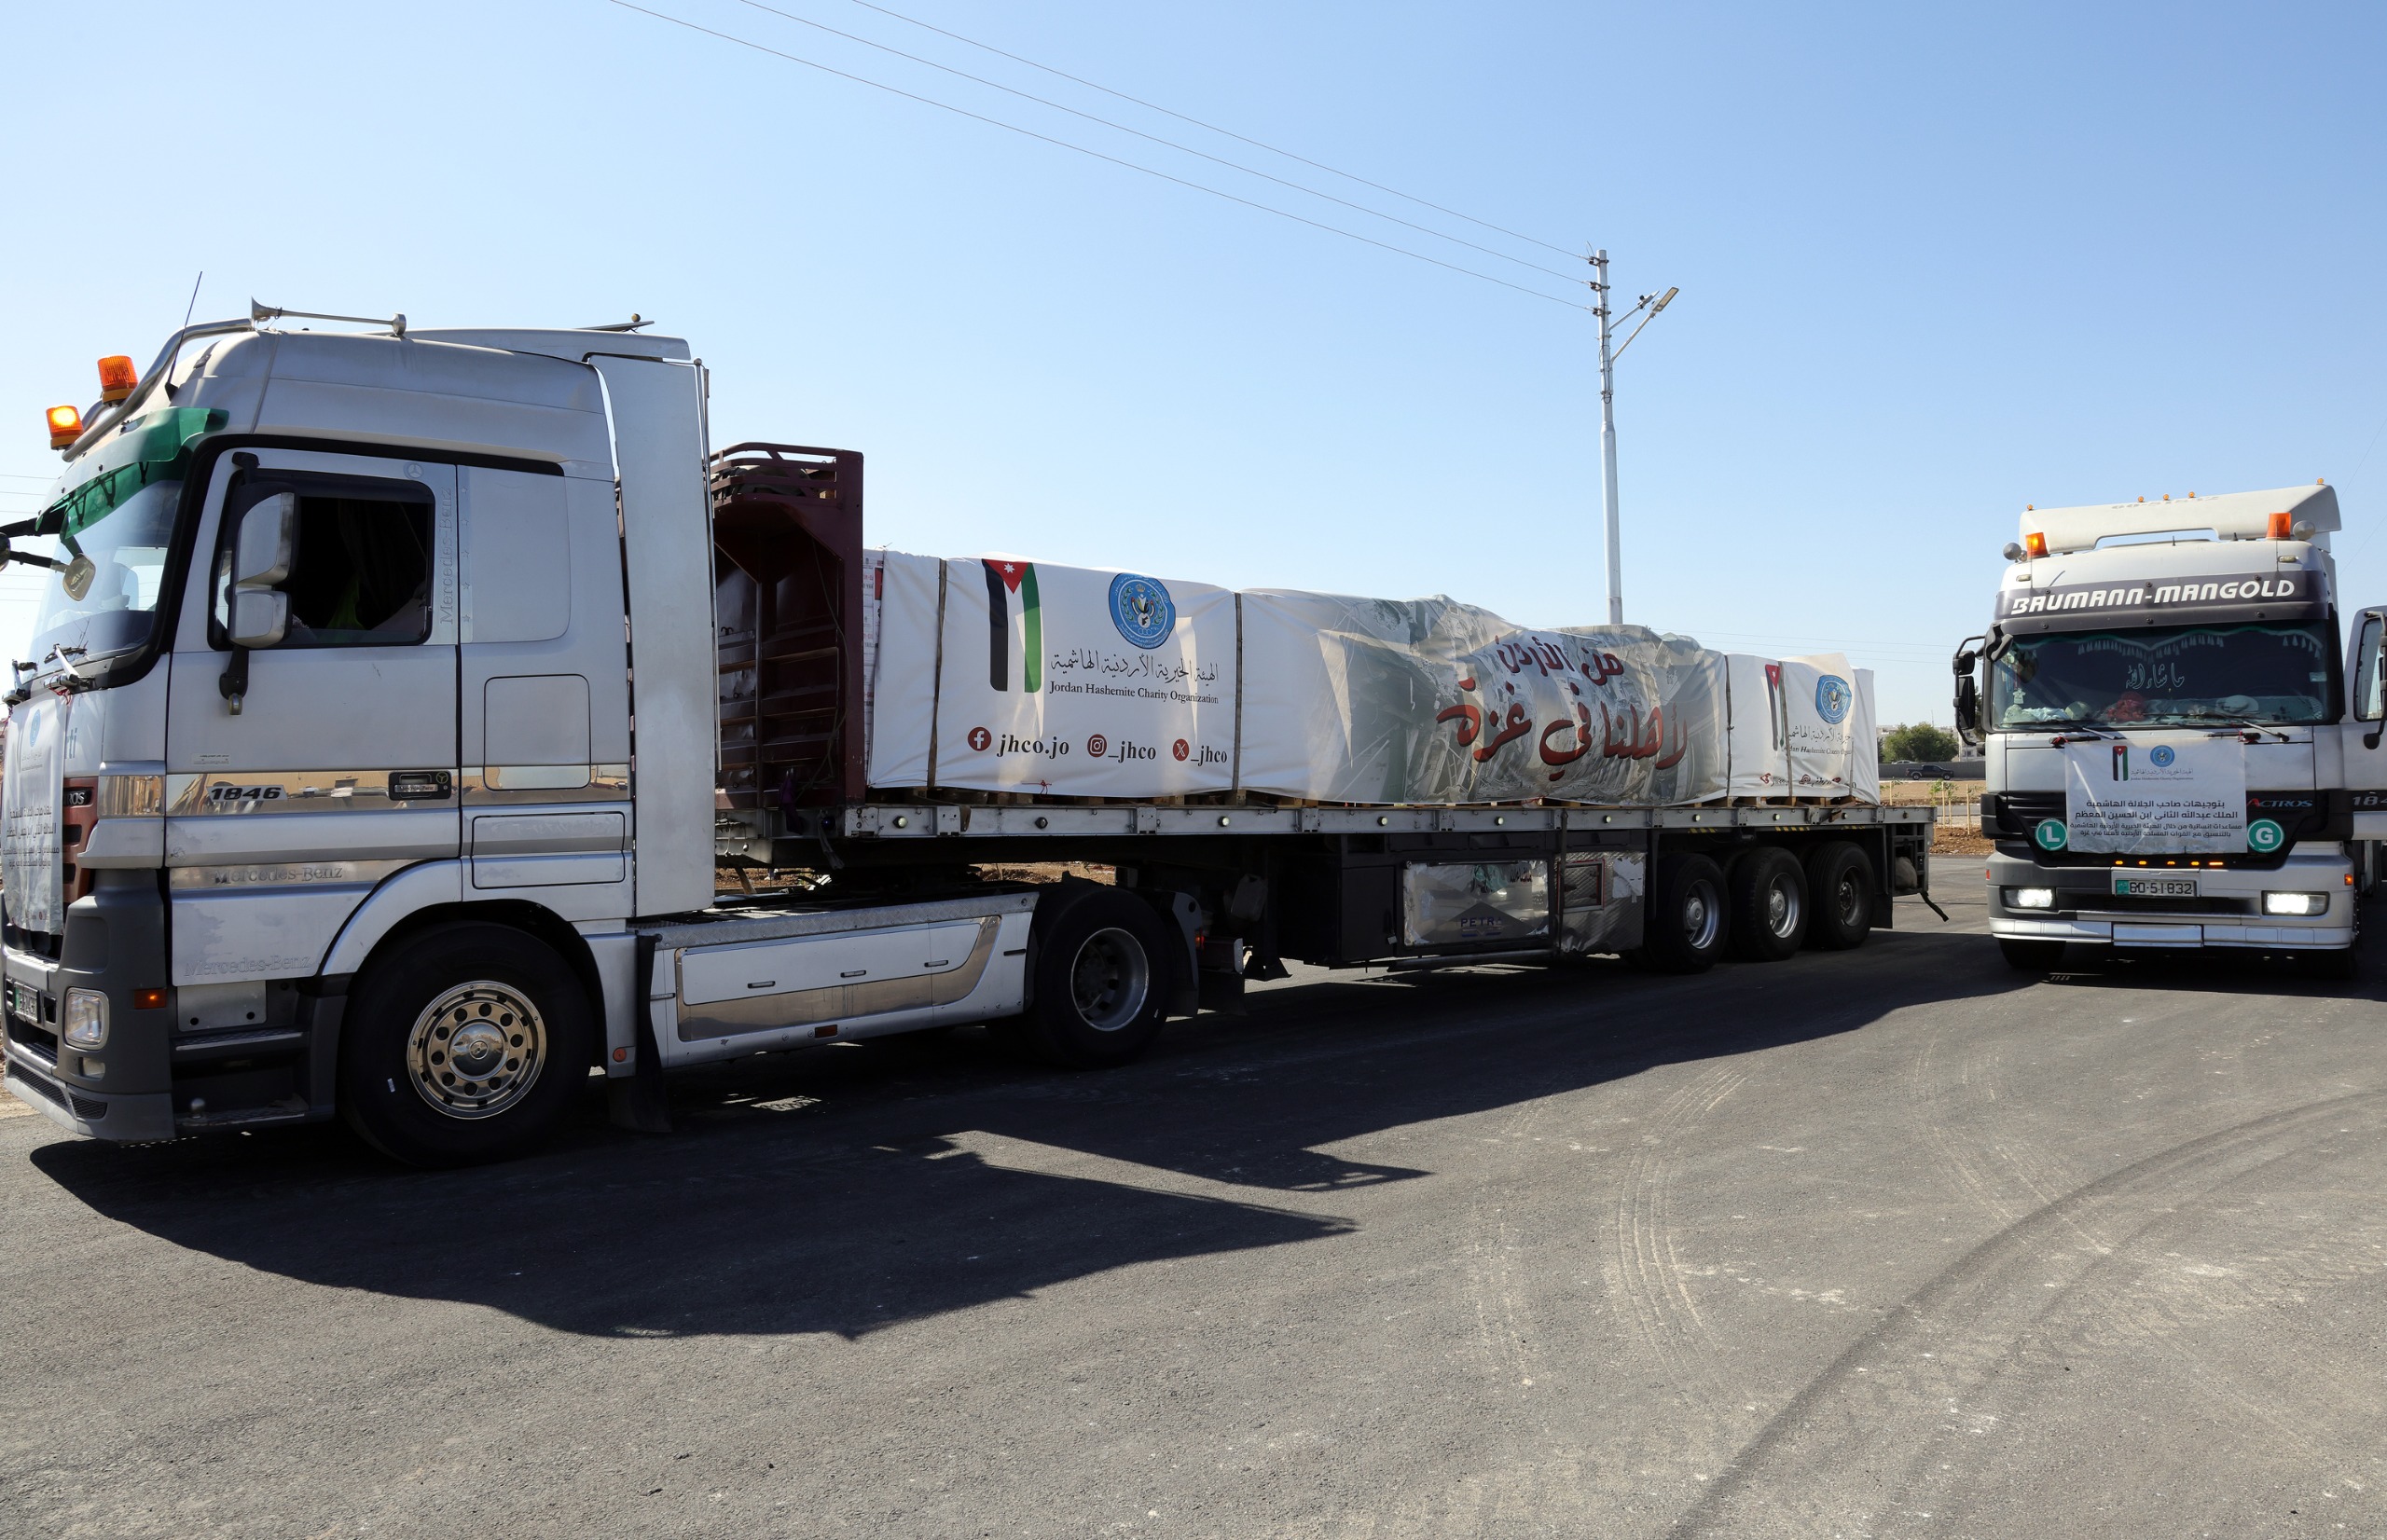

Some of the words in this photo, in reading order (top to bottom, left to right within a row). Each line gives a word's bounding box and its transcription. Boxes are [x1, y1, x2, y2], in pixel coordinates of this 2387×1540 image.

[439, 488, 455, 626] Mercedes-Benz
[2010, 579, 2296, 615] BAUMANN-MANGOLD
[1050, 648, 1100, 675] الهاشمية
[1101, 653, 1154, 678] الأردنية
[1495, 635, 1576, 678] الأردن
[1580, 646, 1624, 687] من
[1155, 656, 1193, 683] الخيرية
[1194, 661, 1220, 686] الهيئة
[1049, 681, 1083, 694] Jordan
[1085, 682, 1136, 697] Hashemite
[1138, 687, 1169, 701] Charity
[1170, 690, 1220, 705] Organization
[1435, 676, 1533, 763] غزة
[1538, 681, 1594, 782] في
[1600, 700, 1689, 771] لأهلنا
[997, 734, 1070, 760] jhco.jo
[1108, 740, 1157, 764] _jhco
[1190, 745, 1228, 767] _jhco
[210, 786, 283, 801] 1846
[2086, 799, 2126, 809] الهاشمية
[2128, 800, 2155, 808] الجلالة
[2156, 800, 2181, 809] صاحب
[2183, 800, 2226, 809] بتوجيهات
[2245, 797, 2313, 808] ACTROS
[2075, 810, 2106, 819] المعظم
[2107, 811, 2138, 820] الحسين
[2139, 811, 2152, 820] ابن
[2154, 810, 2179, 821] الثاني
[2044, 825, 2061, 843] L
[2255, 826, 2274, 845] G
[214, 866, 344, 885] Mercedes-Benz
[184, 954, 313, 977] Mercedes-Benz
